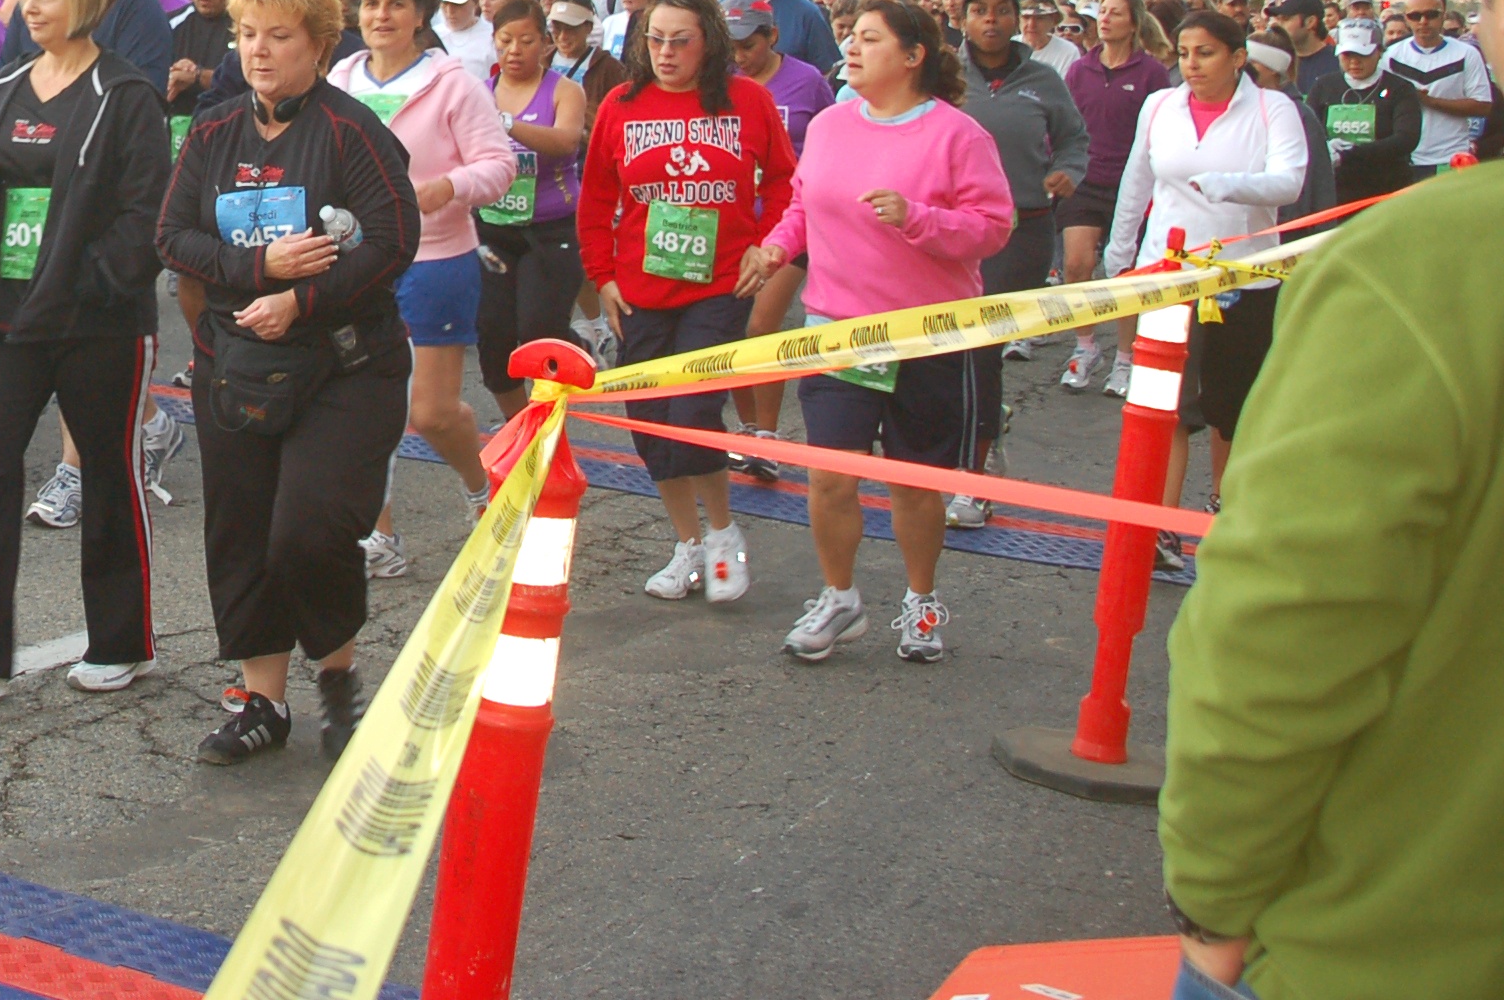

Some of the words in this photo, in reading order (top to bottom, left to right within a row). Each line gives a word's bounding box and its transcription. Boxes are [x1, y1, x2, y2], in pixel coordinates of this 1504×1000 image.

[1332, 120, 1370, 134] 5652
[623, 119, 686, 167] FRESNO
[688, 116, 742, 161] STATE
[629, 180, 736, 206] BULLDOGS
[231, 224, 294, 248] 8457
[652, 230, 707, 256] 4878
